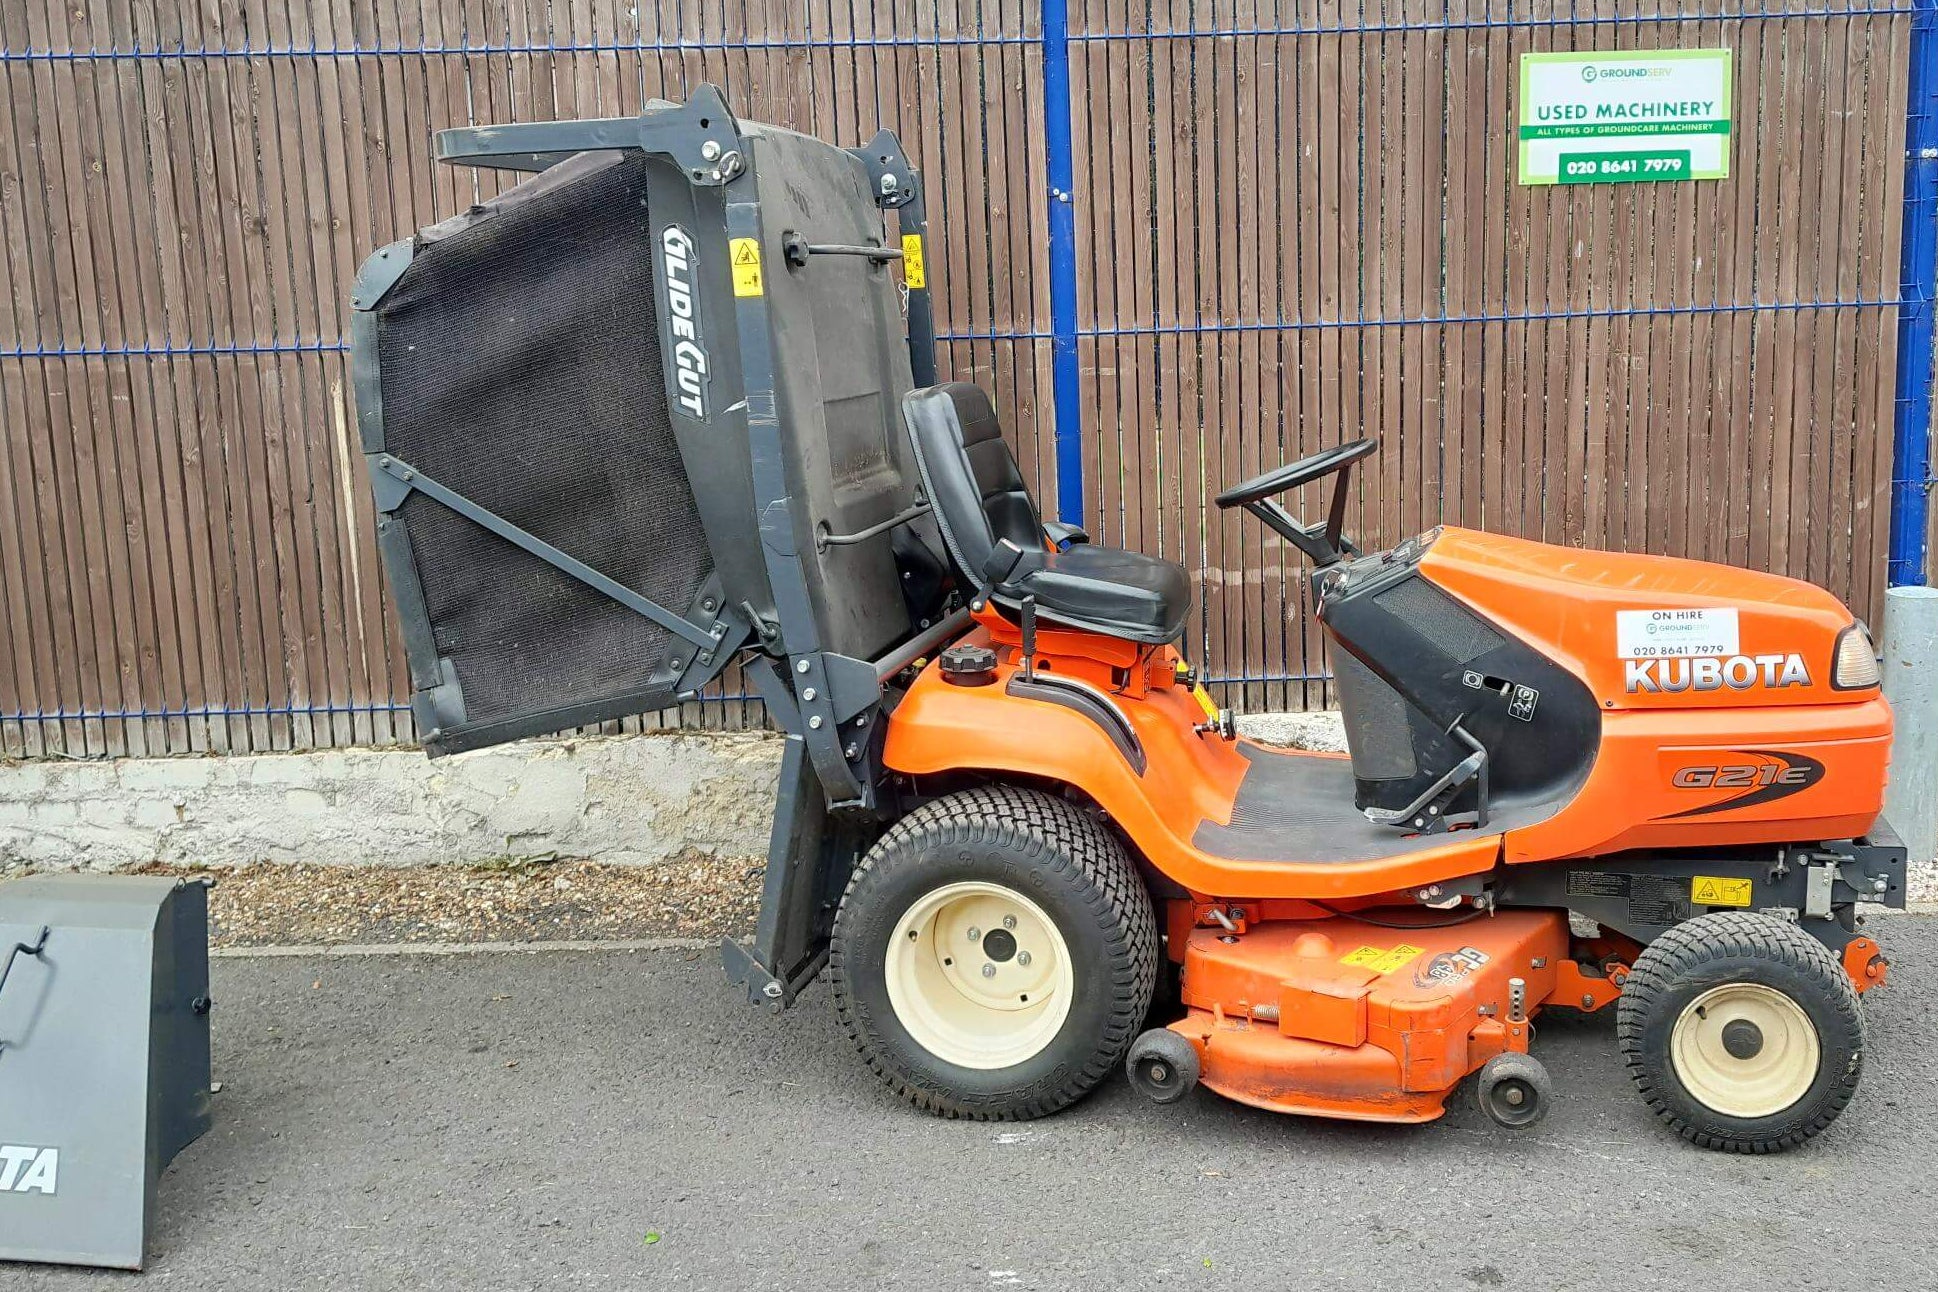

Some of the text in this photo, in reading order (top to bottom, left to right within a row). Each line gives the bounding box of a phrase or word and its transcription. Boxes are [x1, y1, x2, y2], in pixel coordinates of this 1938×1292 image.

[1599, 67, 1673, 79] GROUNDSERV
[1537, 100, 1714, 121] USED MACHINERY
[1536, 123, 1714, 136] ALL TYPES OF GROUNDCARE MACHINERY
[1566, 158, 1683, 175] 020 8641 7979
[1651, 610, 1704, 621] ON HIRE
[1633, 644, 1725, 657] 020 8641 7979
[1625, 653, 1813, 693] KUBOTA
[1672, 763, 1812, 788] G21E
